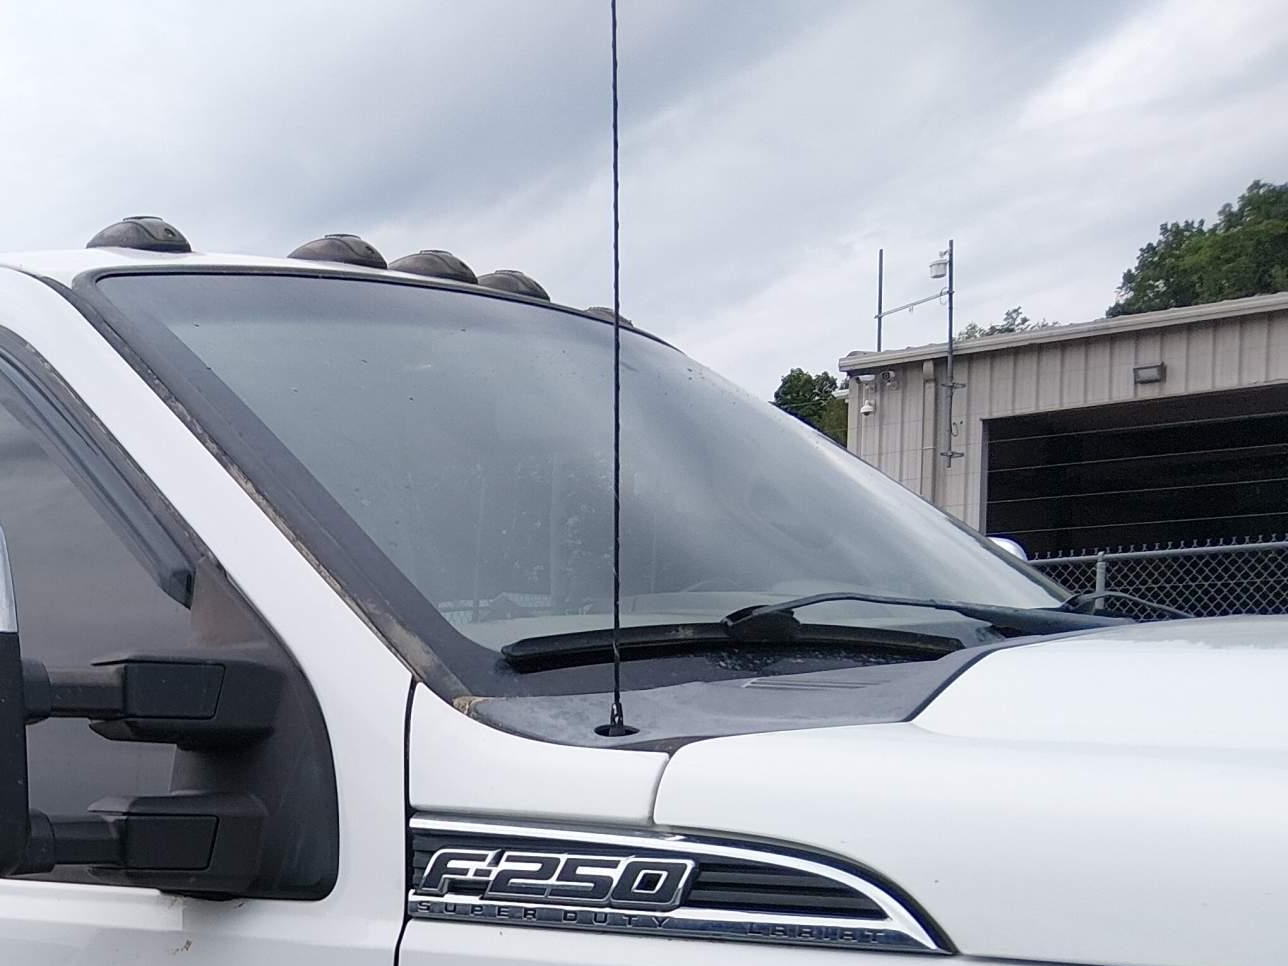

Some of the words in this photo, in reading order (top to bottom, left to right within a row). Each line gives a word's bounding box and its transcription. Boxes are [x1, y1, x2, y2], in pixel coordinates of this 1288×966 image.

[416, 847, 698, 911] F-250
[417, 901, 538, 922] SUPER
[562, 910, 670, 930] DUTY
